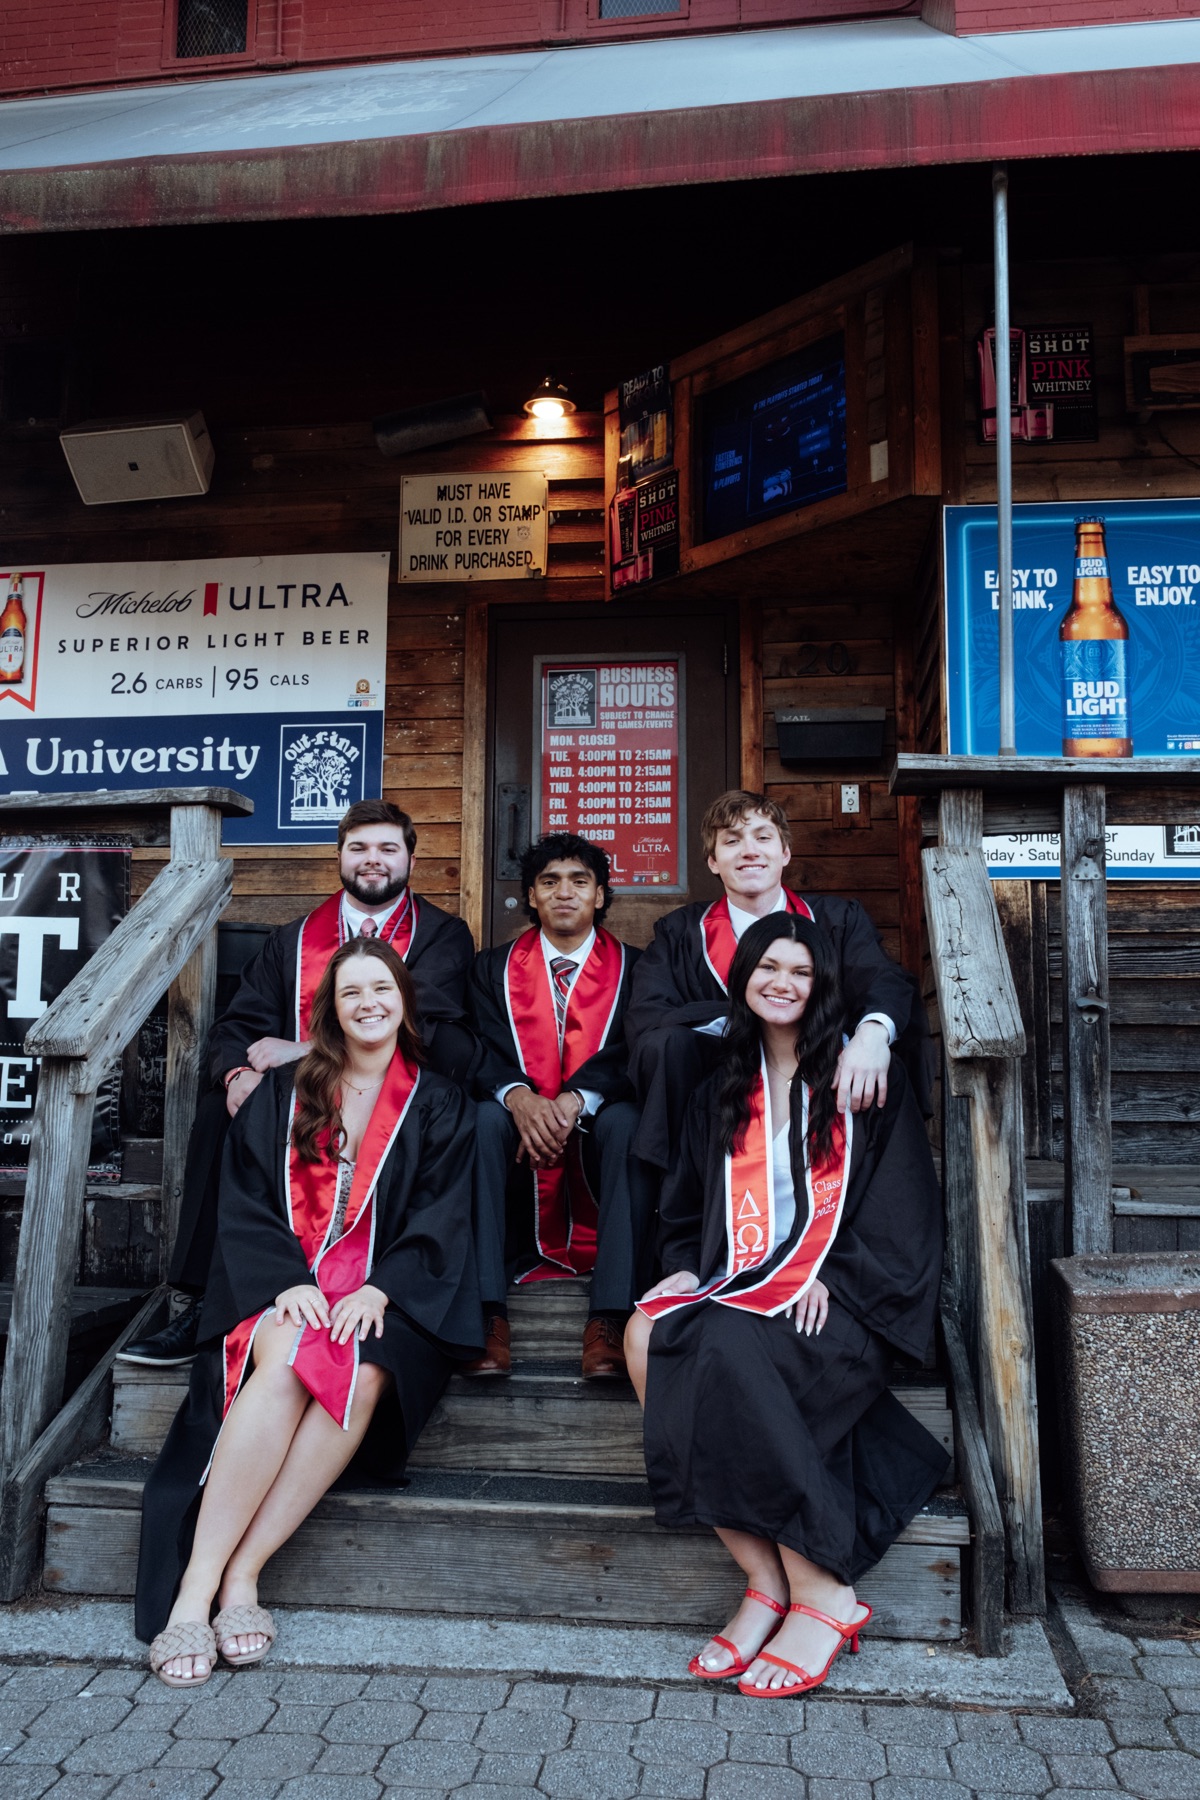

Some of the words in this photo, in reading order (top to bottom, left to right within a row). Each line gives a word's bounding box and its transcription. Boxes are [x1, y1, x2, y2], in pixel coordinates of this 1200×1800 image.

[1029, 338, 1089, 354] SHOT
[1030, 360, 1092, 380] PINK
[623, 371, 650, 397] READY
[652, 365, 664, 383] TO
[788, 380, 808, 396] STARTED
[1032, 380, 1092, 393] WHITNEY
[714, 455, 743, 472] CONFERENCE
[437, 484, 472, 501] MUST
[478, 483, 511, 499] HAVE
[640, 484, 676, 508] SHOT
[448, 507, 466, 523] I.D.
[473, 506, 491, 522] OR
[640, 502, 676, 531] PINK
[436, 530, 462, 547] FOR
[468, 529, 510, 546] EVERY
[640, 520, 676, 542] WHITNEY
[410, 554, 448, 571] DRINK
[455, 550, 536, 569] PURCHASED.
[1080, 559, 1103, 568] BUD
[1033, 568, 1058, 588] TO
[1076, 567, 1107, 577] LIGHT
[1127, 566, 1176, 585] EASY
[1176, 565, 1200, 584] TO
[76, 590, 197, 618] Michelob
[229, 583, 349, 611] ULTRA
[1135, 586, 1196, 606] ENJOY.
[58, 636, 189, 654] SUPERIOR
[207, 632, 284, 648] LIGHT
[303, 630, 369, 645] BEER
[797, 642, 849, 674] 20
[111, 672, 147, 694] 2.6
[155, 678, 203, 690] CARBS
[226, 668, 259, 690] 95
[270, 674, 310, 686] CALS
[600, 666, 675, 684] BUSINESS
[600, 683, 675, 707] HOURS
[1073, 681, 1120, 698] BUD
[600, 711, 632, 720] SUBJECT
[633, 711, 643, 719] TO
[645, 710, 675, 719] CHANGE
[1066, 698, 1127, 716] LIGHT
[601, 721, 615, 729] FOR
[617, 720, 673, 729] GAMES/EVENTS
[550, 735, 575, 746] MON.
[578, 735, 616, 746] CLOSED
[26, 736, 261, 780] University
[550, 751, 571, 762] TUE.
[578, 750, 616, 761] 4:00PM
[619, 750, 632, 761] TO
[635, 749, 671, 760] 2:15AM
[549, 767, 575, 777] WED.
[578, 766, 616, 777] 4:00PM
[619, 766, 632, 776] TO
[635, 765, 671, 776] 2:15AM
[549, 783, 572, 793] THU.
[578, 782, 616, 793] 4:00PM
[619, 781, 632, 792] TO
[635, 781, 671, 792] 2:15AM
[549, 798, 567, 809] FRI.
[578, 798, 616, 809] 4:00PM
[619, 797, 632, 808] TO
[635, 797, 671, 808] 2:15AM
[549, 814, 569, 825] SAT.
[578, 814, 616, 825] 4:00PM
[619, 813, 632, 824] TO
[635, 813, 671, 824] 2:15AM
[577, 830, 615, 841] CLOSED
[1008, 832, 1060, 845] Spring
[632, 844, 671, 853] ULTRA
[984, 849, 1015, 863] iday
[1028, 848, 1059, 861] Satu
[1104, 848, 1155, 863] Sunday
[814, 1180, 841, 1194] Class
[823, 1192, 834, 1205] of
[814, 1202, 836, 1220] 2025
